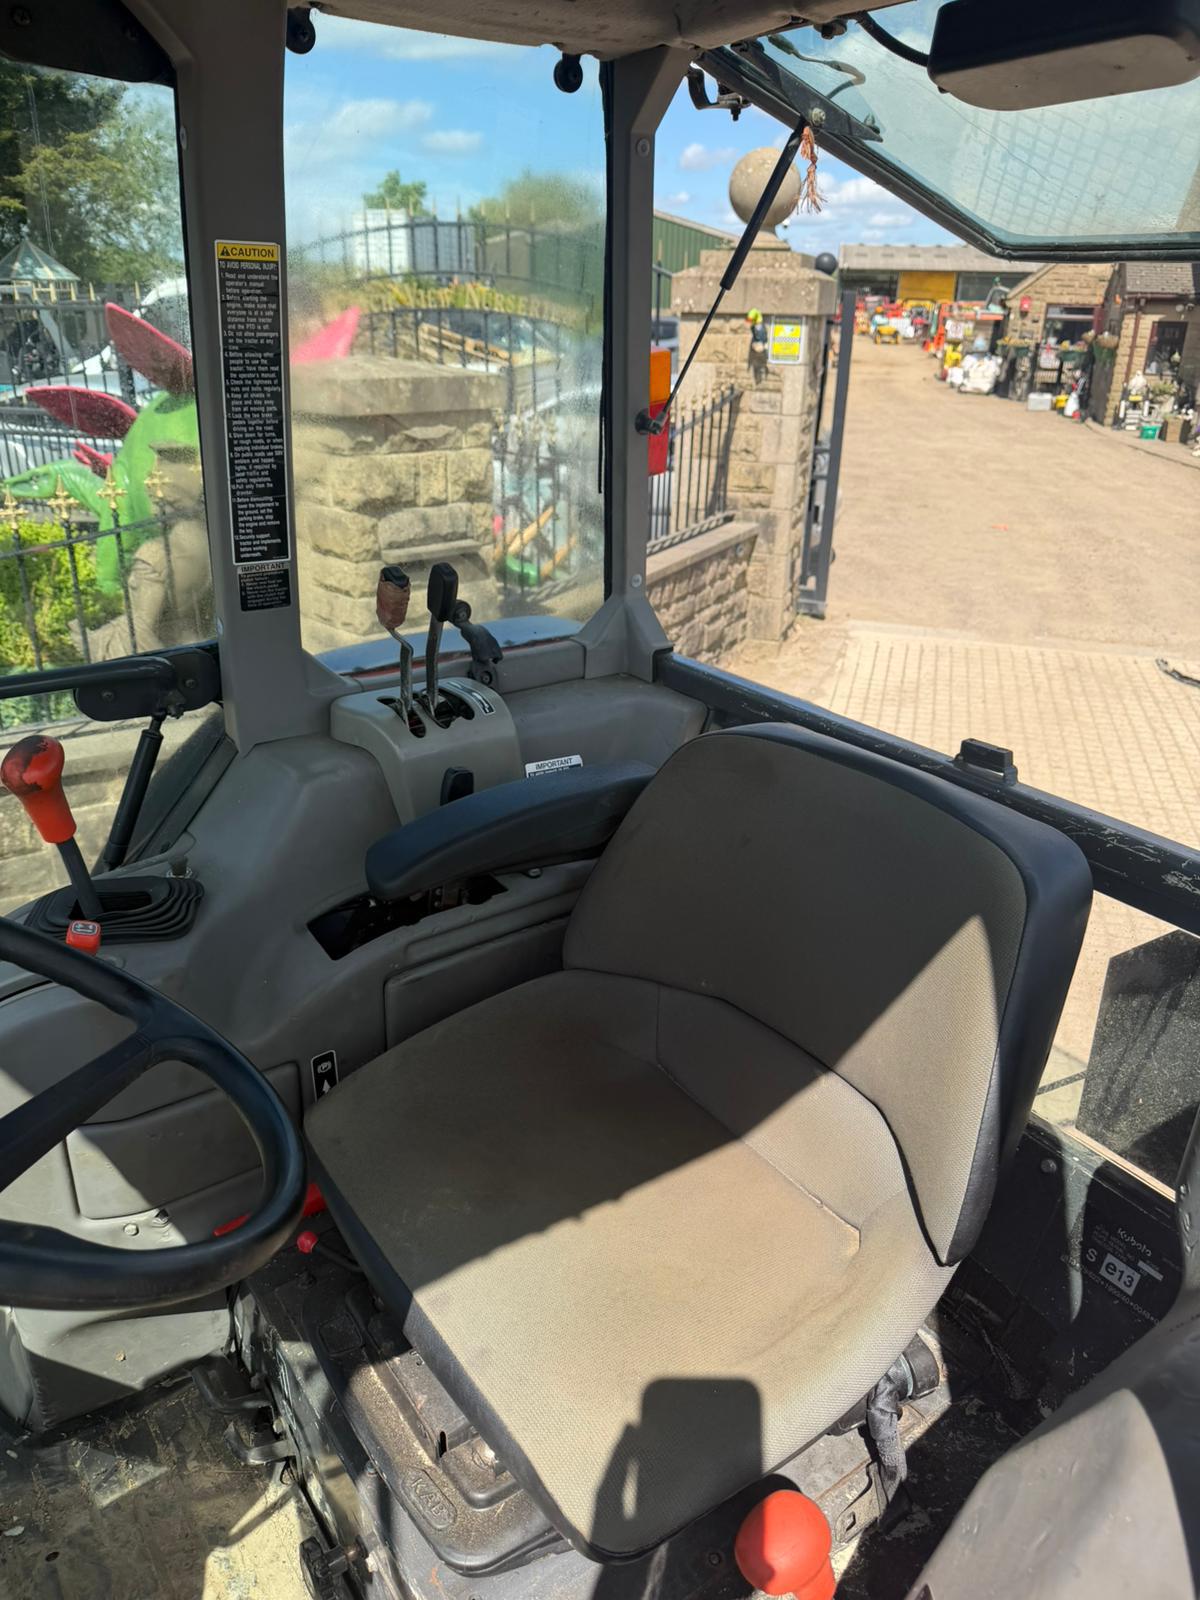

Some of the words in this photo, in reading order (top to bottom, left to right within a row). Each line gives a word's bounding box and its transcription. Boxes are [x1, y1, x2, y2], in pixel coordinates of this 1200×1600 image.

[231, 247, 274, 258] CAUTION
[242, 563, 284, 572] IMPORTANT
[536, 758, 572, 770] IMPORTANT
[1105, 1262, 1135, 1289] e13
